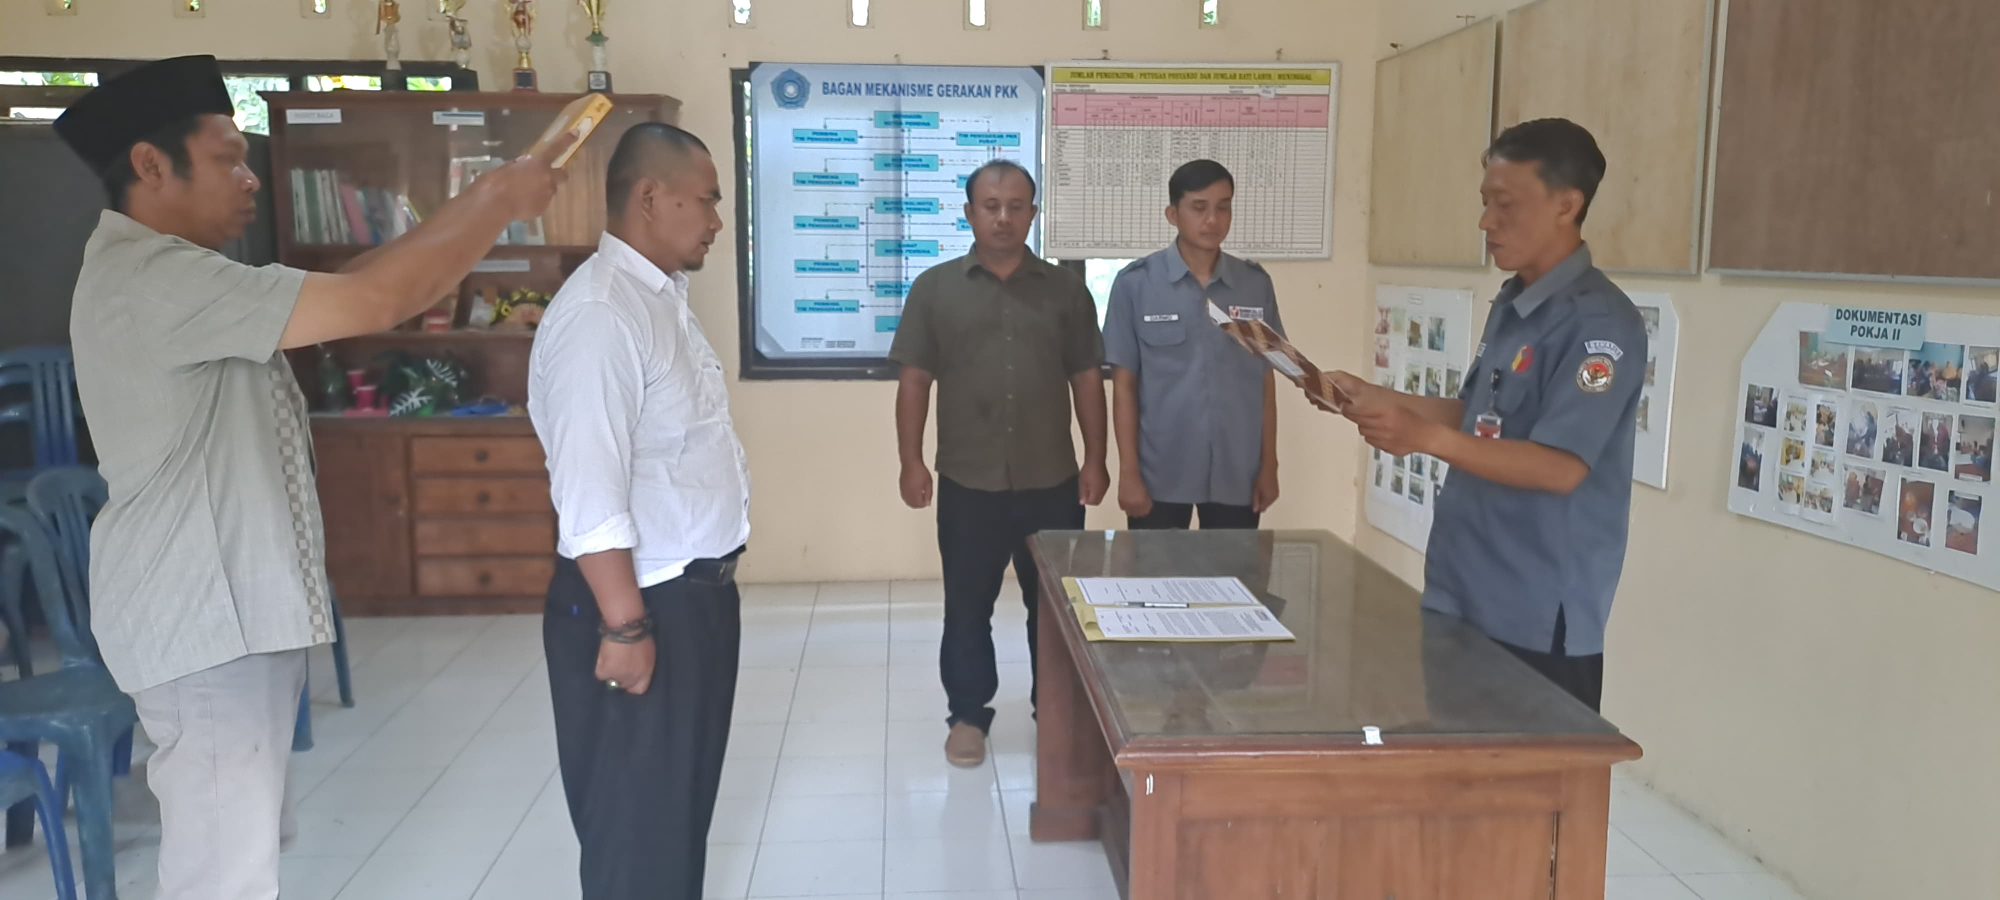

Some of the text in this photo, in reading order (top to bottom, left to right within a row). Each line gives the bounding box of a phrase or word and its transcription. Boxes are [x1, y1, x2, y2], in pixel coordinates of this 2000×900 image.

[822, 81, 1019, 99] BAGAN MEKANISME GERAKAN PKK
[1835, 308, 1923, 327] DOKUMENTASI
[1850, 324, 1901, 341] POKJA II
